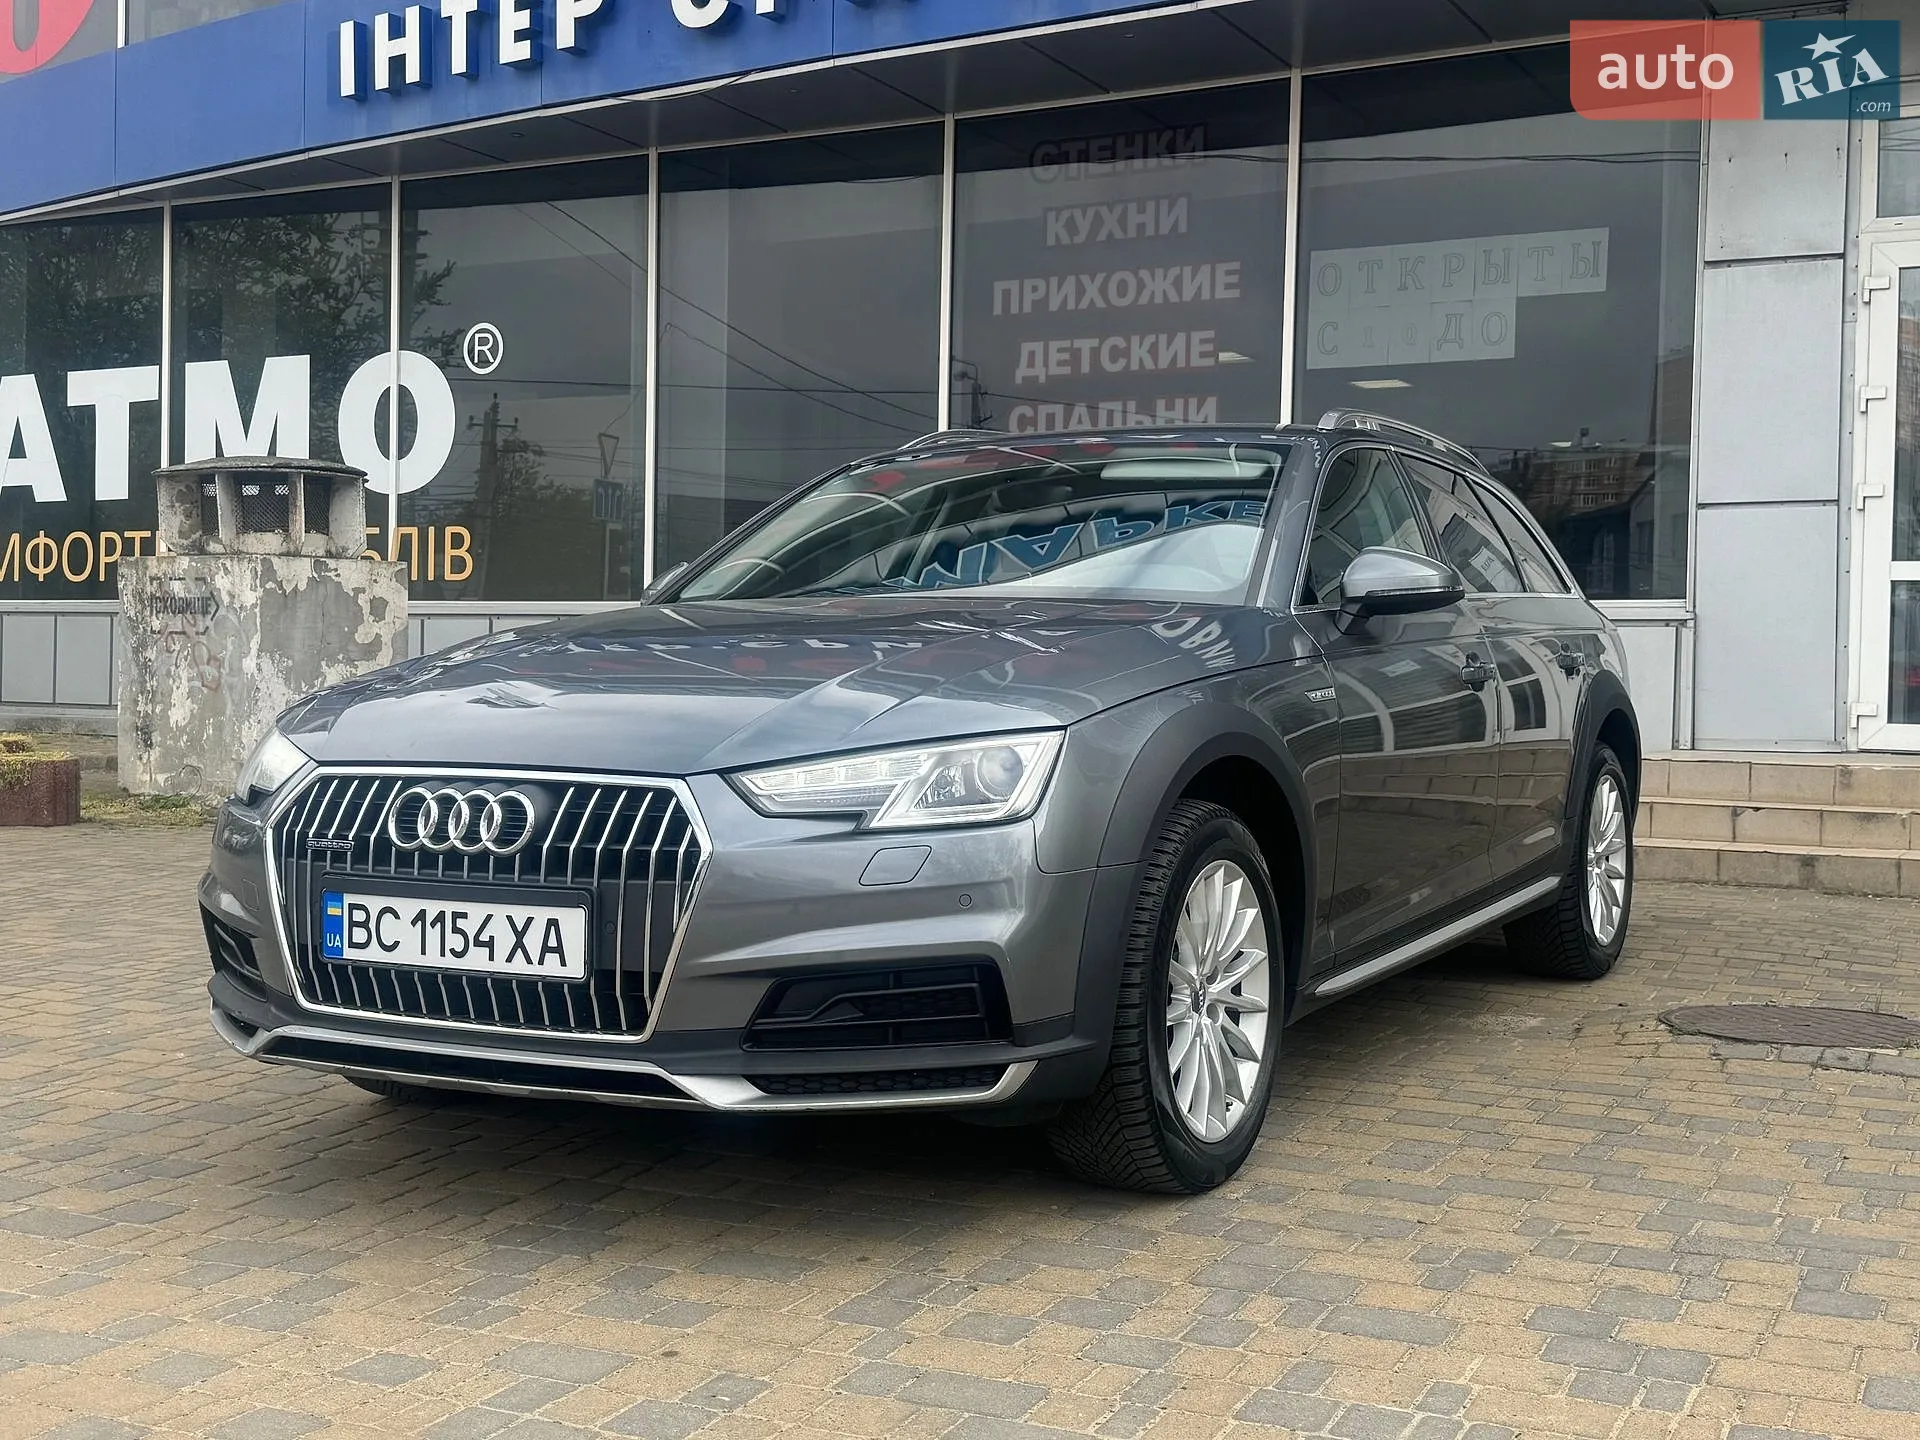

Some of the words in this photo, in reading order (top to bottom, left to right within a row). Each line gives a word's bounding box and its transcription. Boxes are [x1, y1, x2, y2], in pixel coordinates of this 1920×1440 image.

[1031, 125, 1206, 183] СТЕНКИ
[1046, 197, 1188, 246] КУХНИ
[993, 261, 1241, 316] ПРИХОЖИЕ
[1316, 241, 1602, 297] ОТКРЫТЫ
[1015, 330, 1217, 384] ДЕТСКИЕ
[1437, 312, 1508, 356] ДО
[307, 841, 351, 849] quattro
[327, 932, 343, 948] UA
[347, 902, 401, 953] BC
[410, 908, 496, 962] 1154
[504, 913, 568, 968] XA
